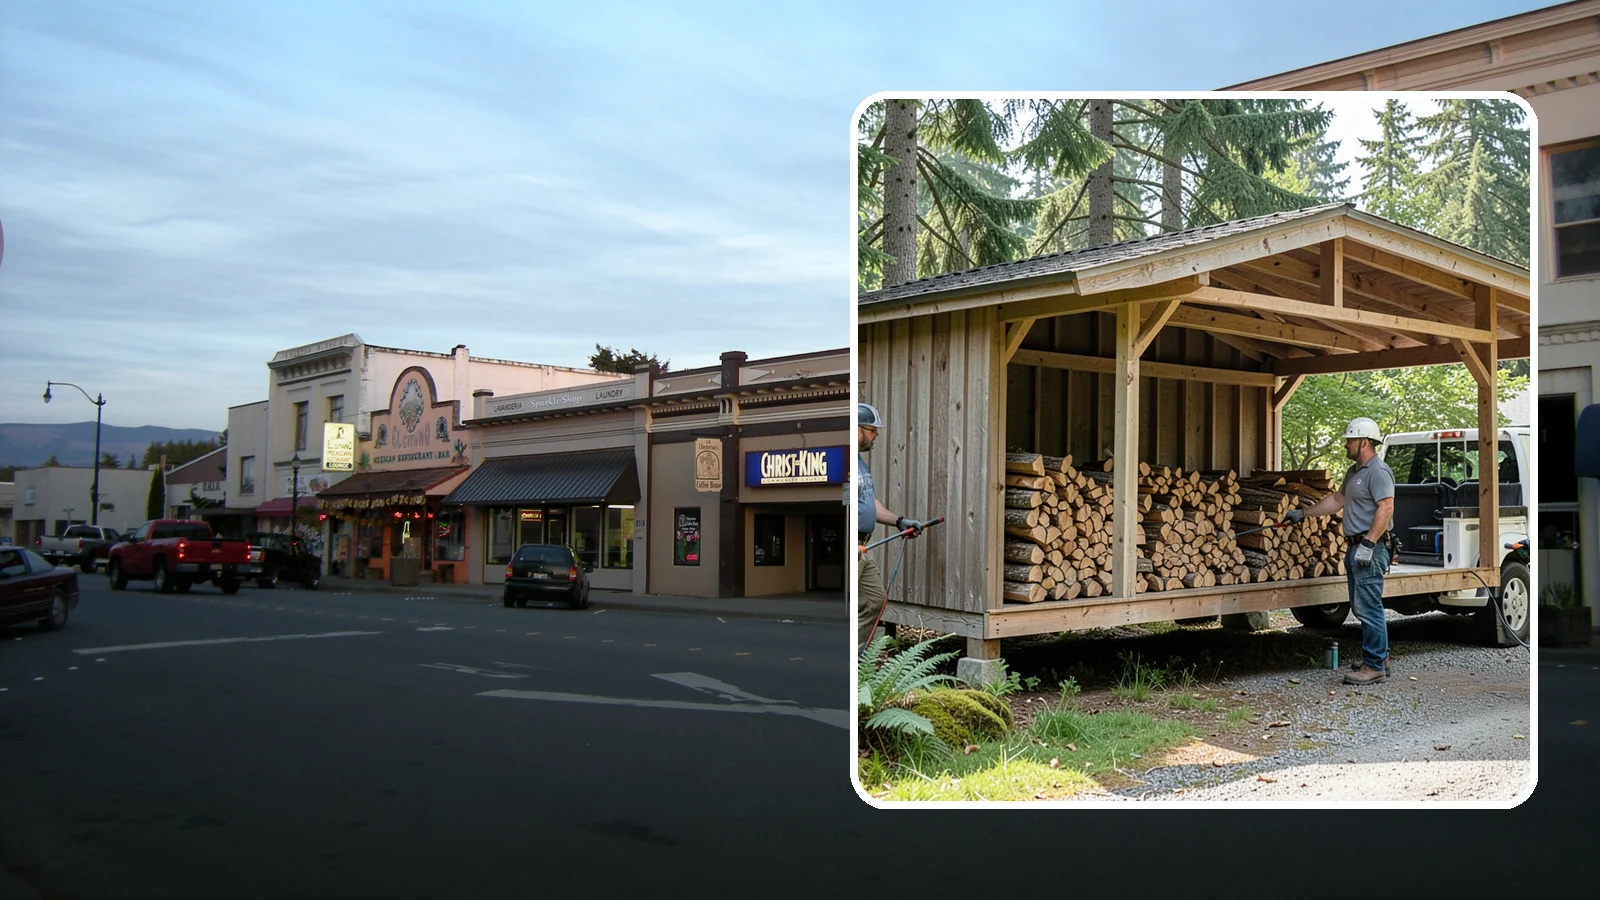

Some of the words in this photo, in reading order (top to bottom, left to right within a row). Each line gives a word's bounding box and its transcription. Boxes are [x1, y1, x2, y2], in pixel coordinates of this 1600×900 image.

[530, 396, 560, 409] Sparkle
[561, 394, 583, 406] Shop
[595, 389, 624, 400] LAUNDRY
[493, 402, 523, 413] LAVANDERIA
[374, 456, 396, 464] MEXICAN
[397, 451, 433, 462] RESTAURANT
[438, 450, 450, 459] BAR
[760, 452, 798, 478] CHRIST
[798, 450, 827, 476] KING
